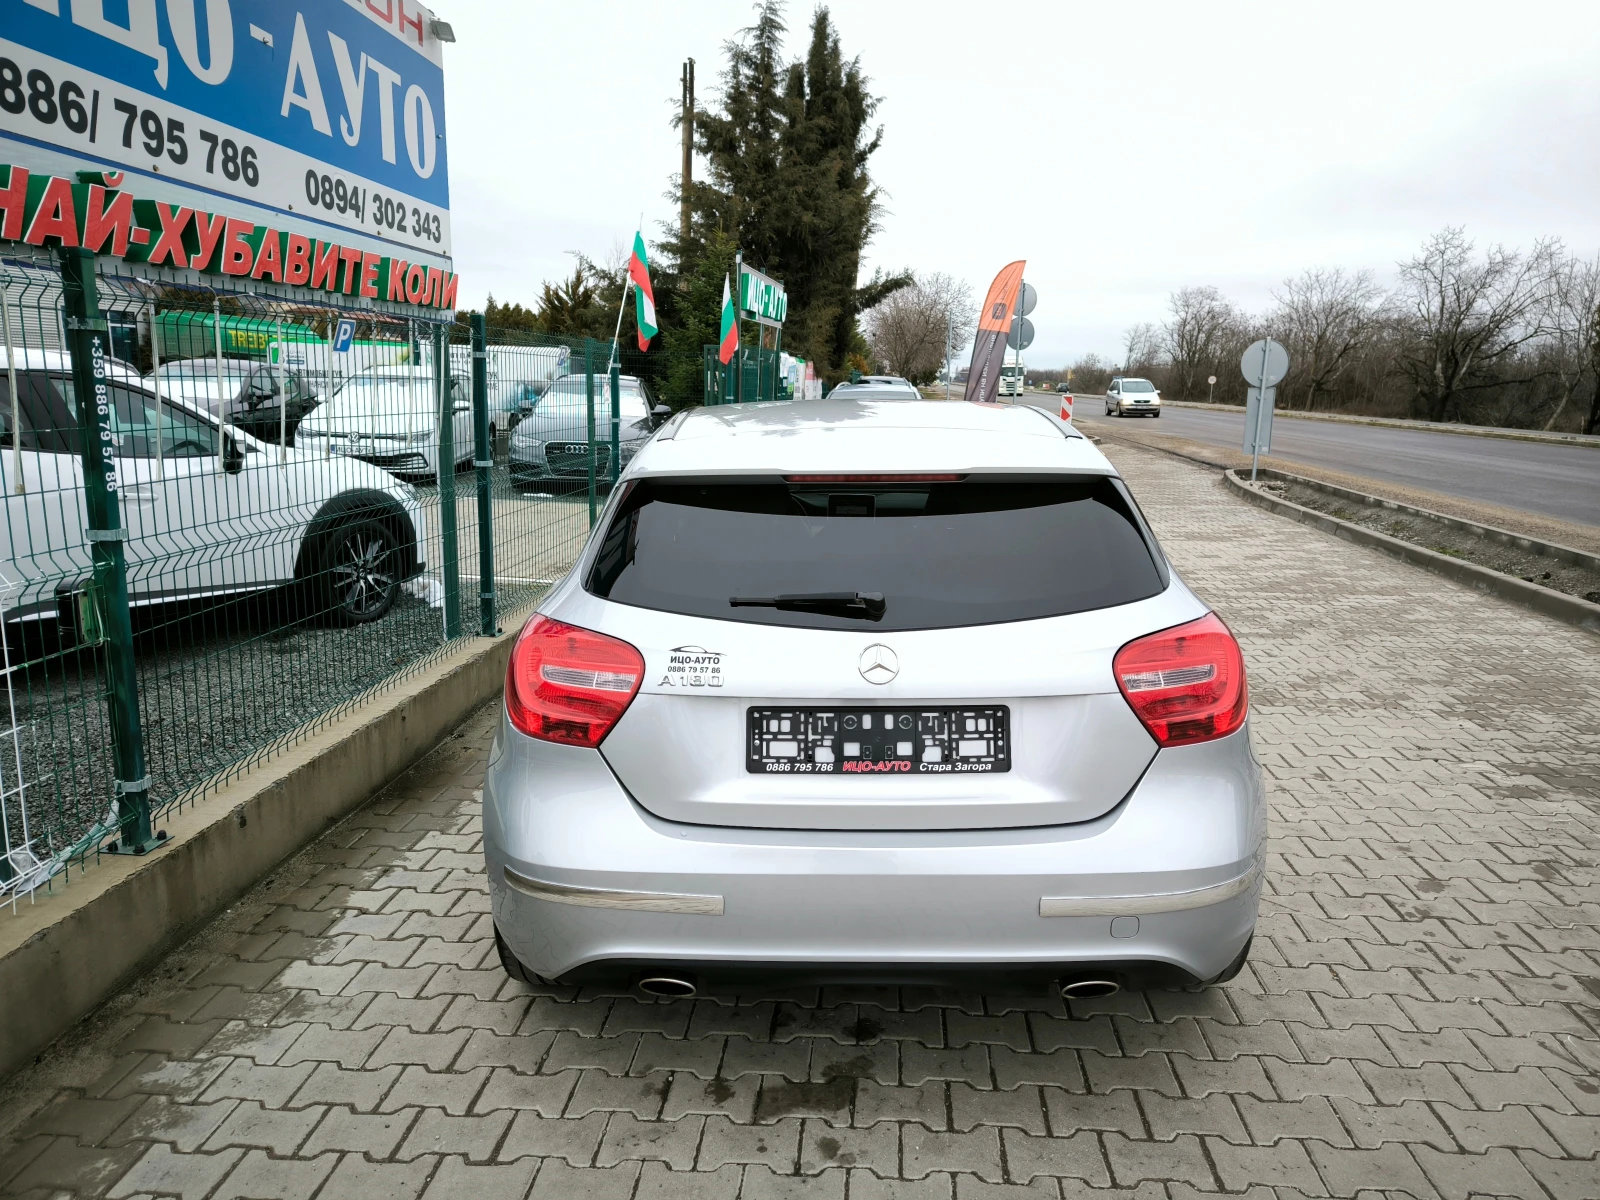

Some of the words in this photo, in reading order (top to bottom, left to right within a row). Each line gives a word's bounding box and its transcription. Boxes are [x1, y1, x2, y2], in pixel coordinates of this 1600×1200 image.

[114, 97, 188, 165] 795
[199, 129, 259, 187] 786
[305, 169, 366, 224] 0894/
[372, 193, 407, 233] 302
[412, 208, 442, 244] 343
[387, 257, 458, 310] КОЛИ
[747, 273, 788, 323] ИЦО-АУТО
[336, 323, 351, 349] P
[92, 336, 105, 379] +359
[95, 384, 108, 415] 886
[99, 420, 111, 440] 79
[102, 447, 115, 466] 57
[105, 471, 117, 492] 86
[667, 665, 686, 673] 0886
[699, 666, 709, 674] 57
[670, 655, 720, 665] ИЦО-АУТО
[766, 763, 791, 772] 0886
[794, 763, 812, 772] 795
[815, 763, 834, 772] 786
[842, 761, 912, 773] ИЦО-АУТО
[919, 762, 952, 773] Стара
[954, 762, 992, 773] Загора
